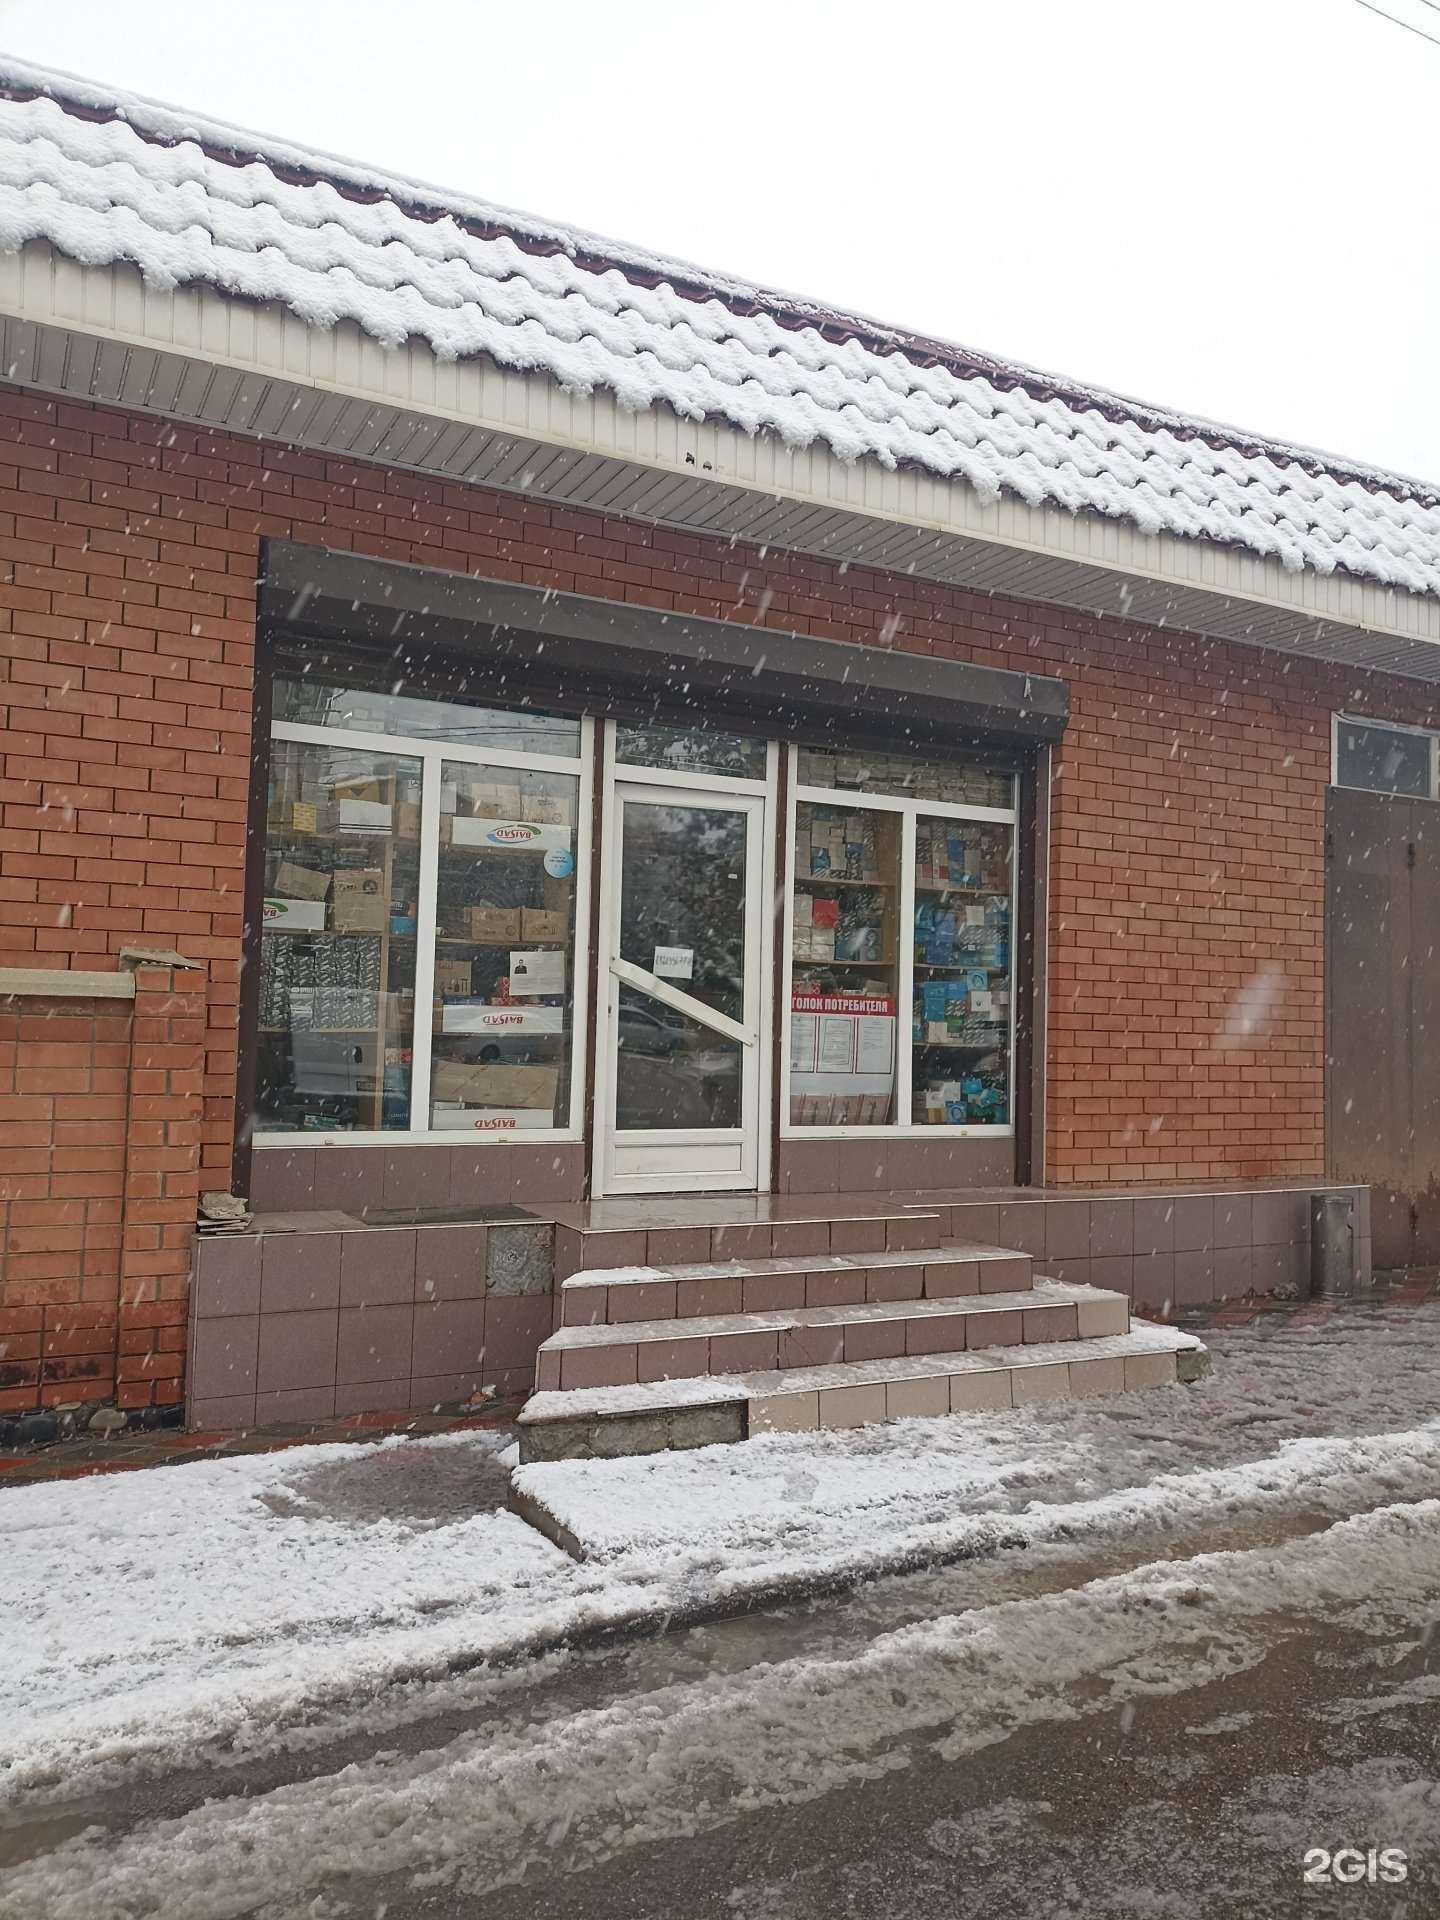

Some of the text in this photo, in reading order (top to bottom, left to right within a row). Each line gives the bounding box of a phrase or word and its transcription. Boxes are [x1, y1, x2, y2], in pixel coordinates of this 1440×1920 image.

[824, 998, 888, 1013] ПОТРЕБИТЕЛЯ
[482, 1013, 524, 1026] BAISAD
[474, 1117, 517, 1130] BAISAD
